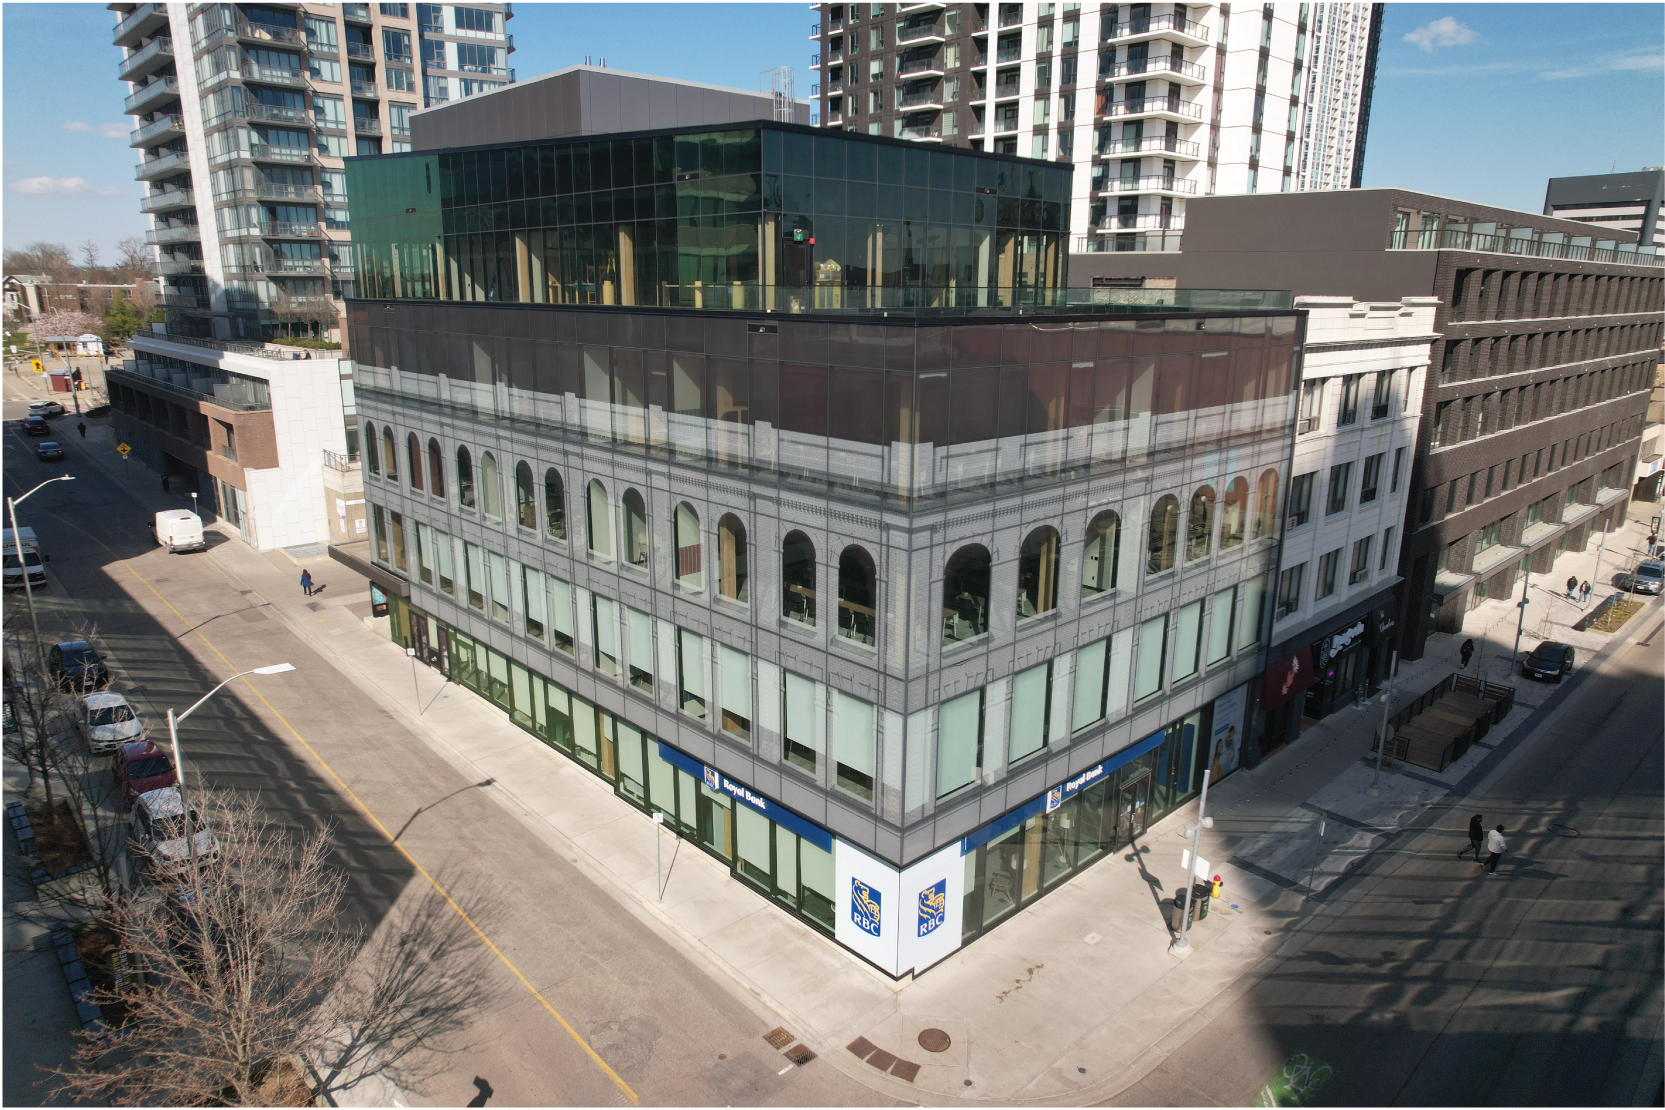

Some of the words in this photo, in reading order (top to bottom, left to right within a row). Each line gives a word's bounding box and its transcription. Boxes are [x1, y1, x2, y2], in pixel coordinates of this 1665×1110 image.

[1066, 773, 1086, 791] Royal
[1086, 764, 1103, 781] Bank
[723, 778, 744, 797] Royal
[745, 790, 766, 809] Bank
[853, 911, 879, 936] RBC
[920, 913, 943, 936] RBC
